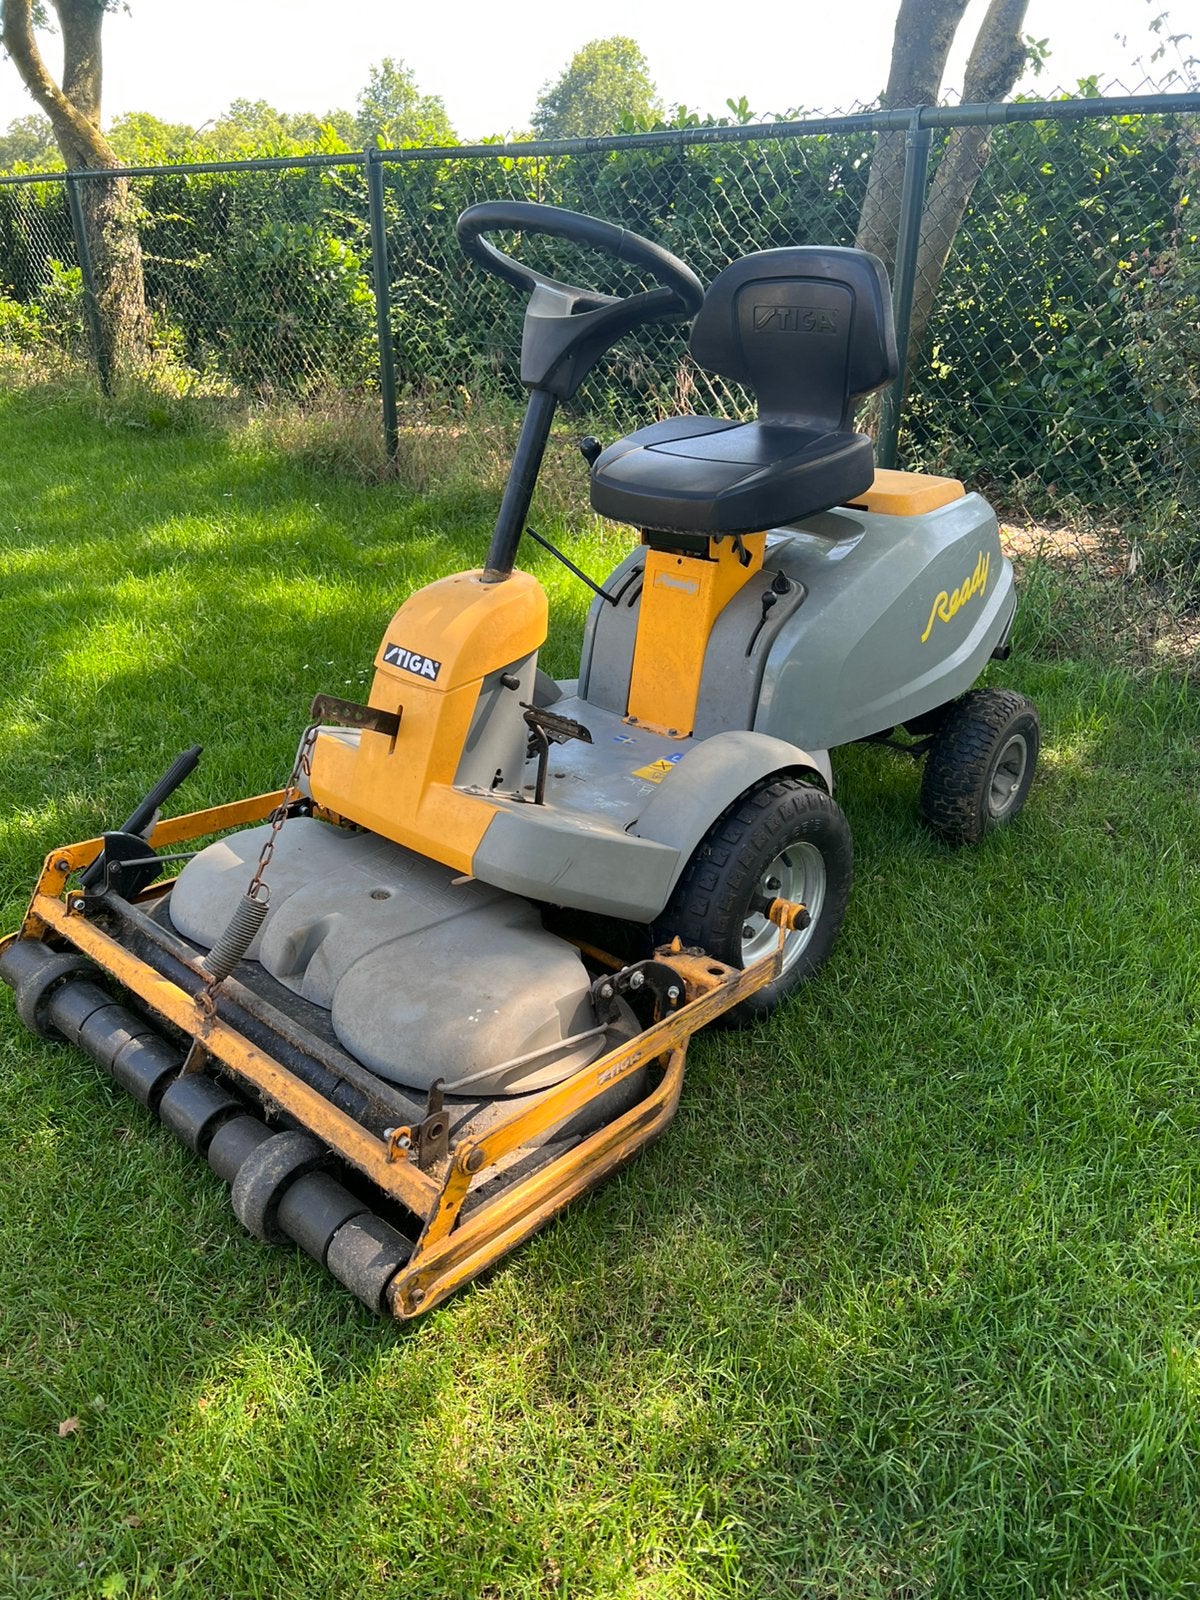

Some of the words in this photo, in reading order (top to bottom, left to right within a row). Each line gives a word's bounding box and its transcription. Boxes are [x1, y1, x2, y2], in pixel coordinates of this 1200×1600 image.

[756, 306, 837, 333] STIGA
[921, 550, 990, 643] Ready
[384, 647, 438, 680] STIGA
